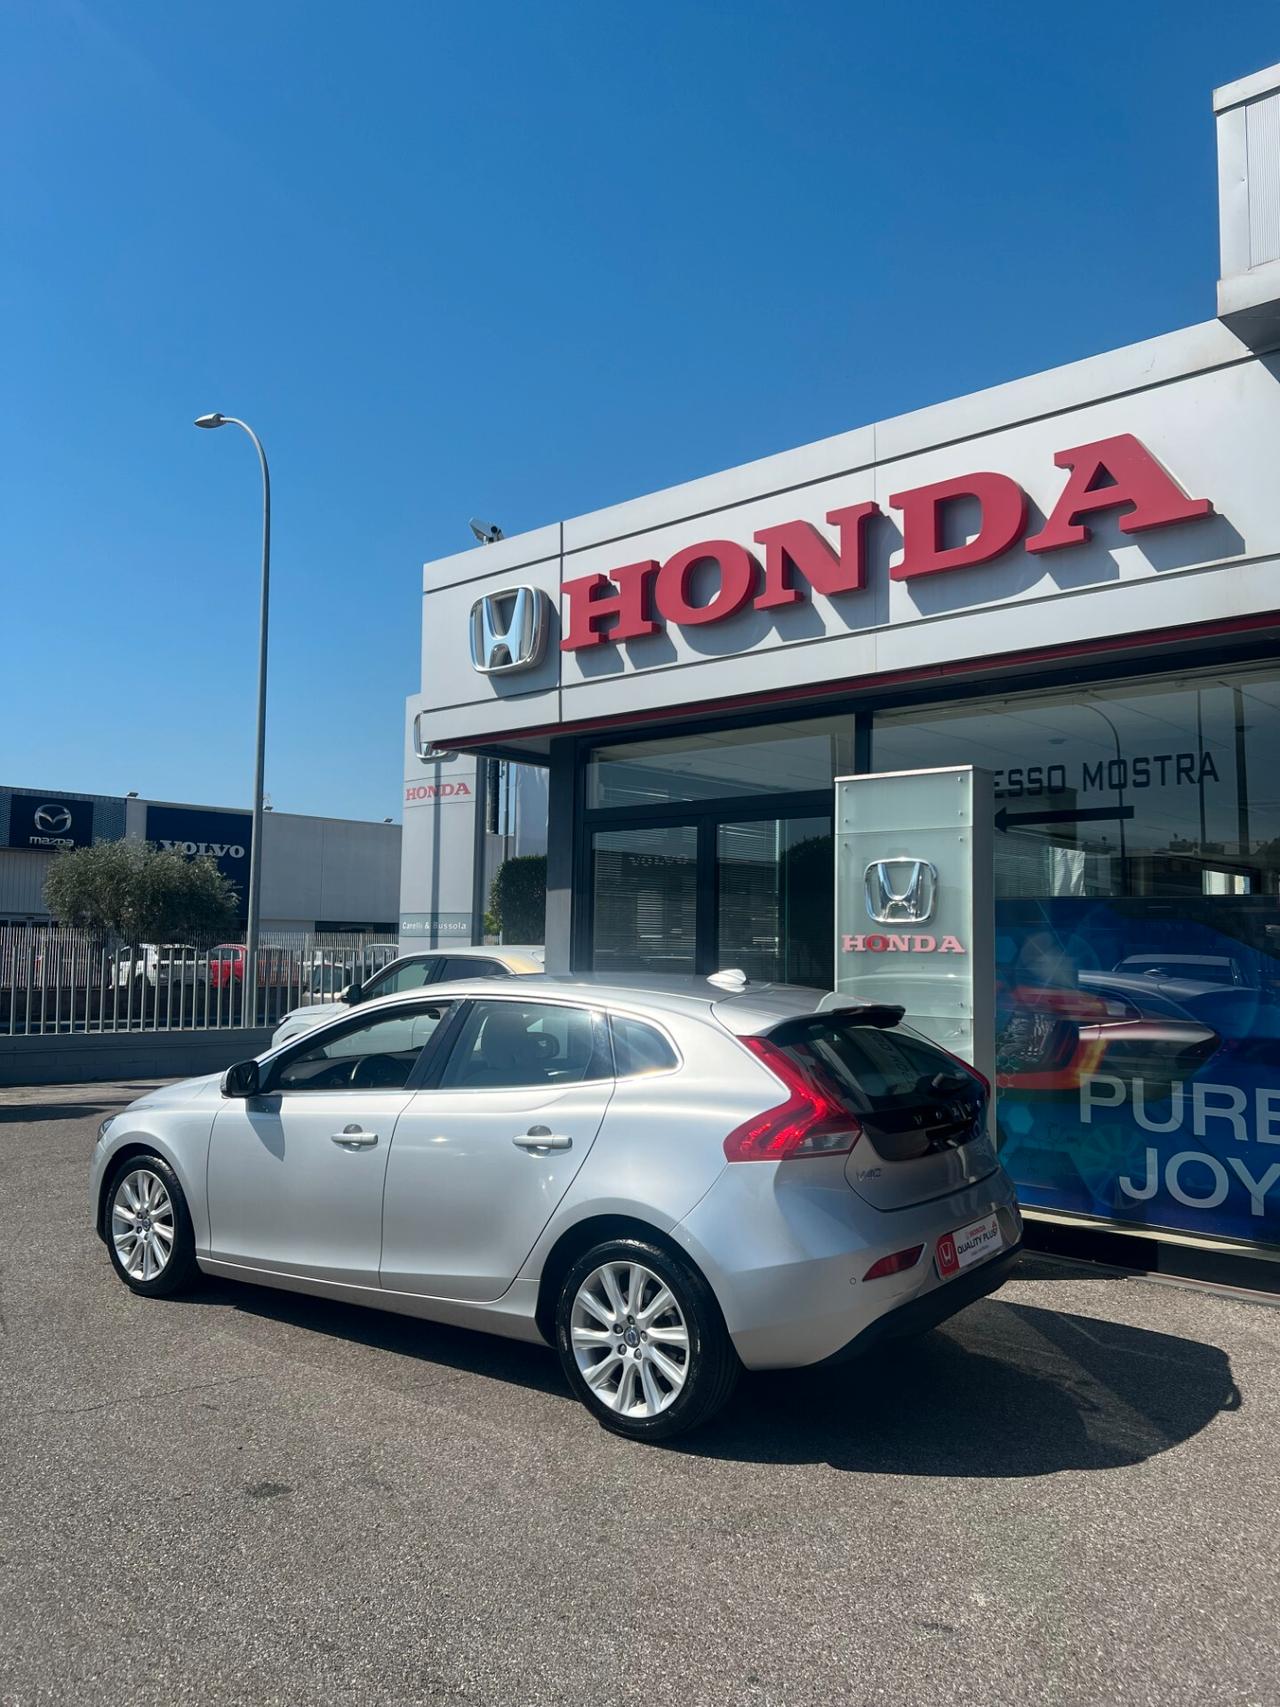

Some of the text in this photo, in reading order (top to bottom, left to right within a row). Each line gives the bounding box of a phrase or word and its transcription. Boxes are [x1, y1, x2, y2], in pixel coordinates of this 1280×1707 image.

[560, 432, 1213, 651] HONDA
[405, 782, 471, 801] HONDA
[993, 751, 1220, 799] ESSO MOSTRA
[159, 839, 245, 859] VOLVO
[841, 934, 966, 953] HONDA
[1079, 1073, 1280, 1145] PURE
[1119, 1147, 1280, 1217] JOY
[957, 1236, 982, 1255] QUALITY
